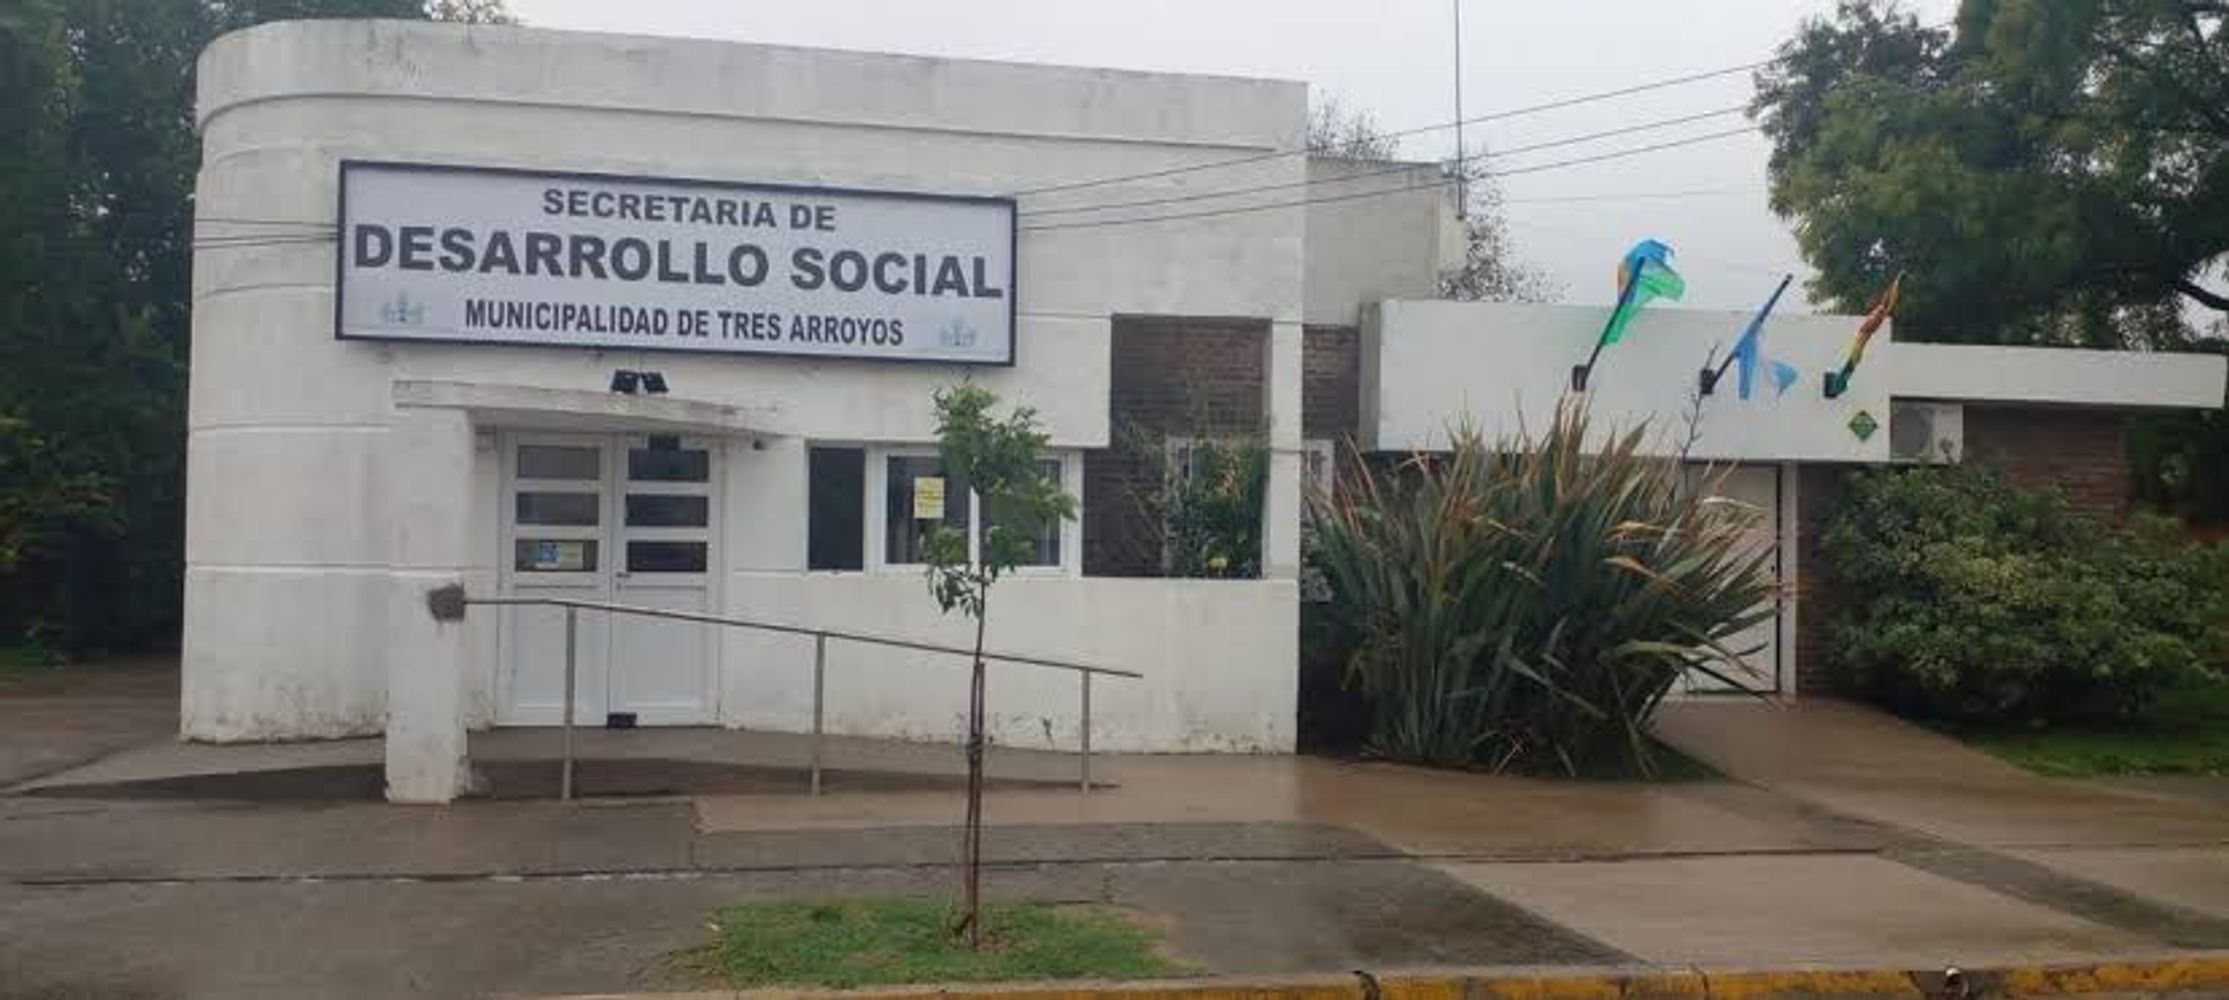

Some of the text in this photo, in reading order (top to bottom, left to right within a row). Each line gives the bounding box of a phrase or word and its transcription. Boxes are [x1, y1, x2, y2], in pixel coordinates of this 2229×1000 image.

[543, 188, 835, 231] SECRETARIA DE
[354, 224, 1003, 298] DESARROLLO SOCIAL
[465, 299, 903, 346] MUNICIPALIDAD DE TRES ARROYOS
